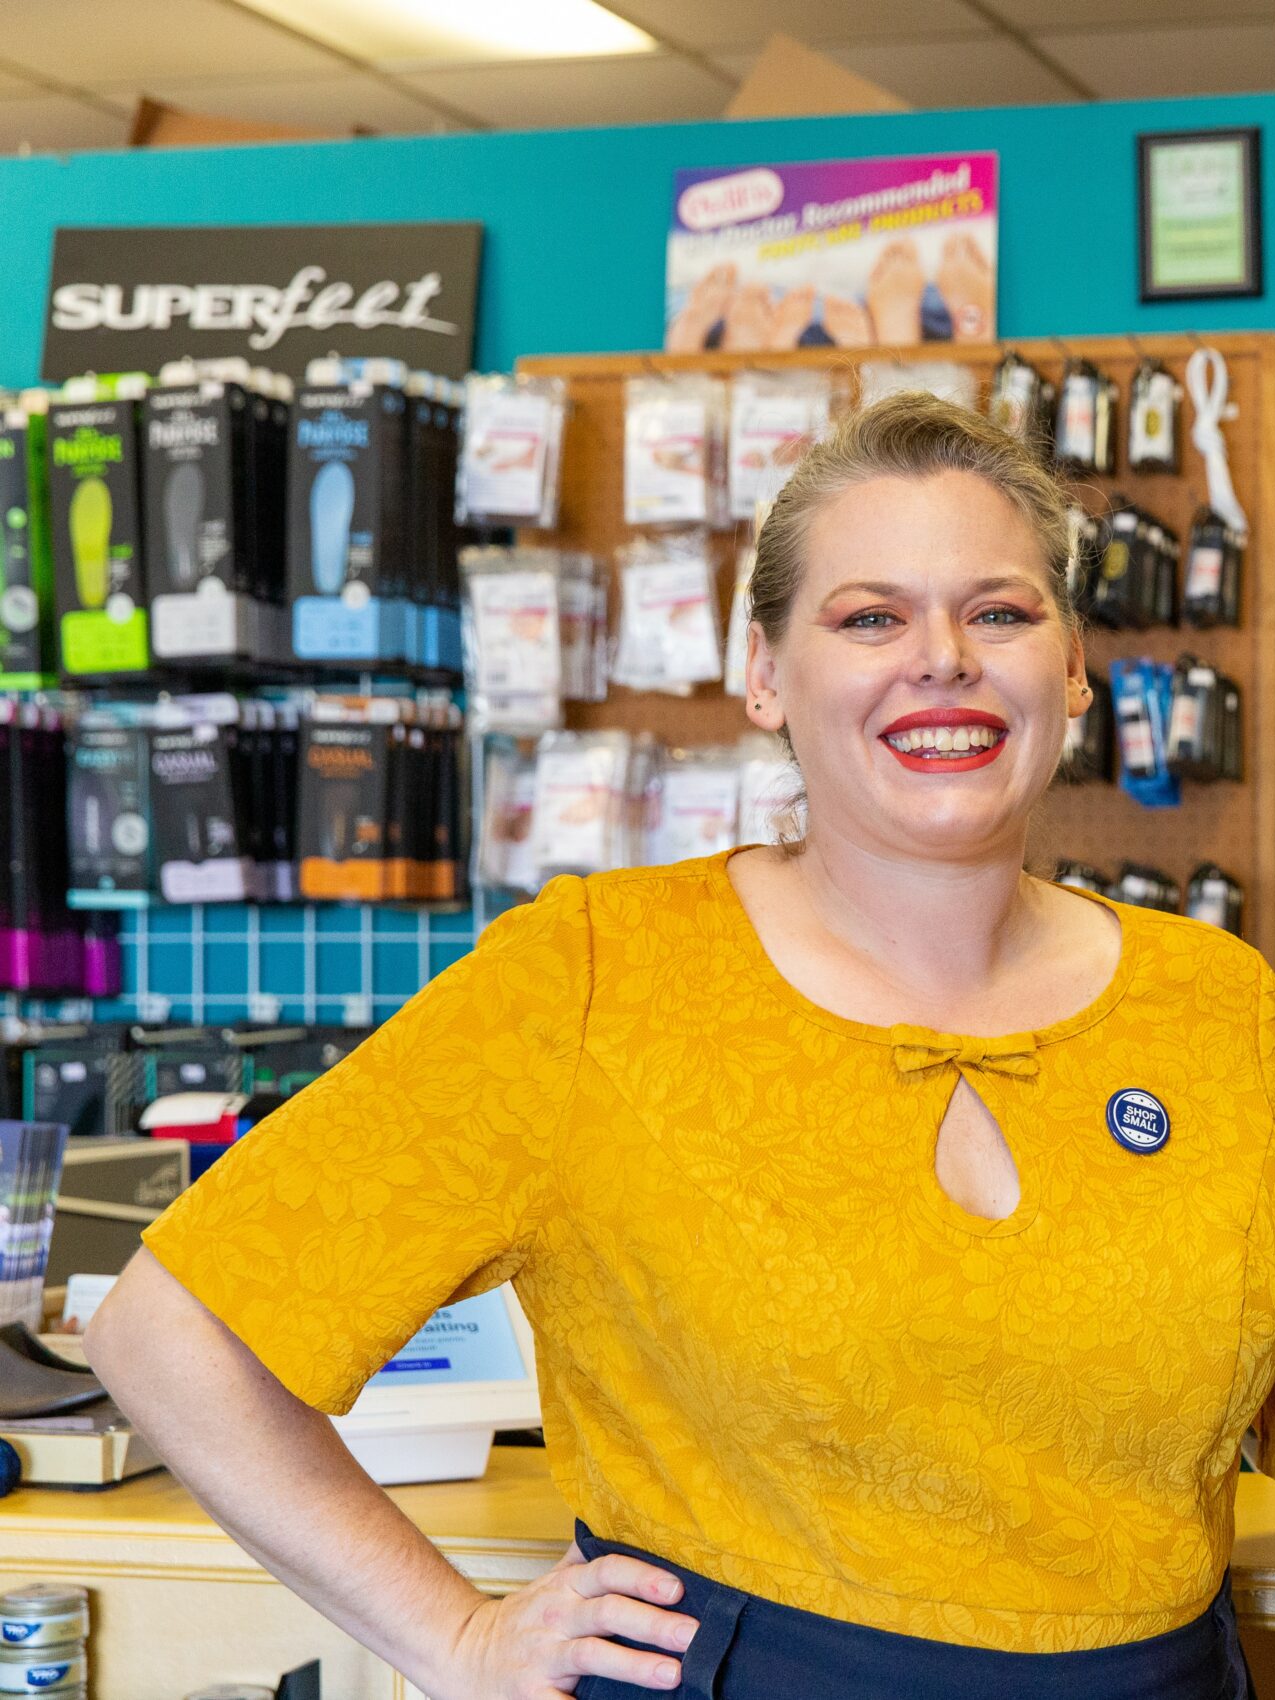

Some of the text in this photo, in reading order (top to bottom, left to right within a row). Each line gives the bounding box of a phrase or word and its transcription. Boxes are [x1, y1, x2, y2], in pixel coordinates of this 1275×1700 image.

[1126, 1105, 1157, 1121] SHOP
[1122, 1114, 1159, 1133] SMALL
[421, 1322, 480, 1333] aiting
